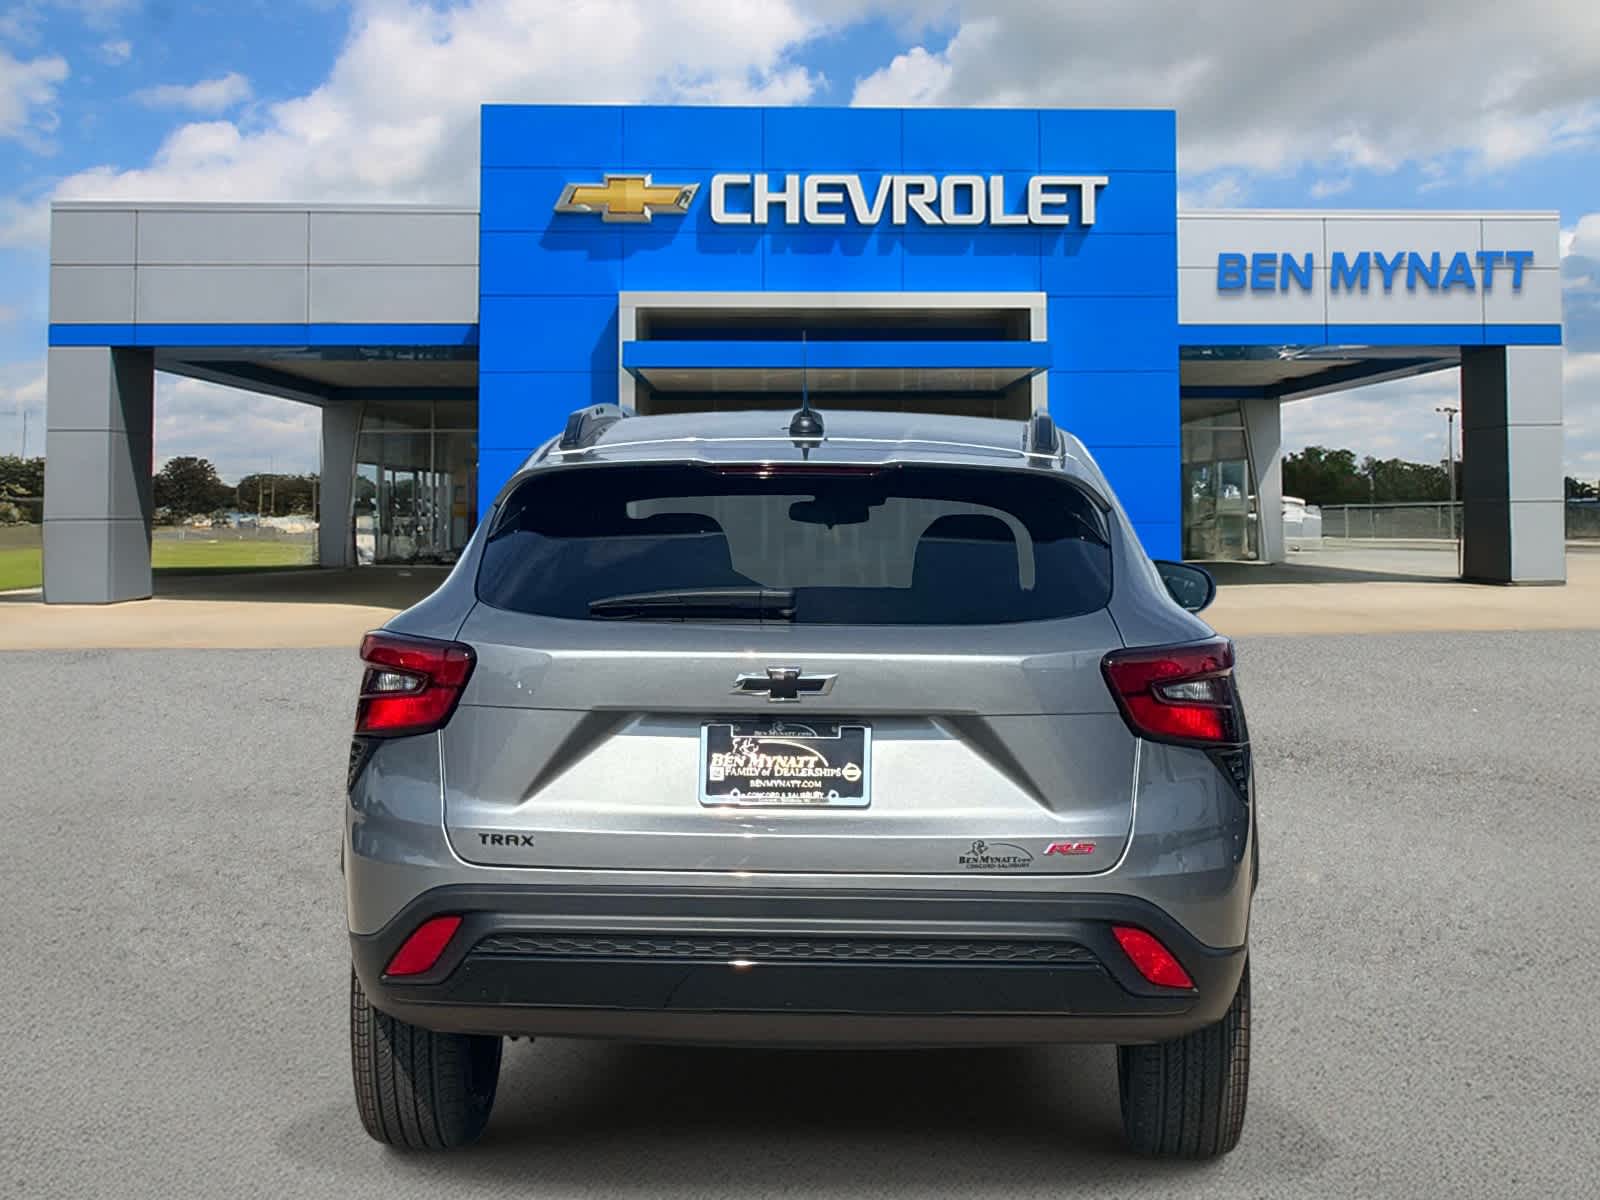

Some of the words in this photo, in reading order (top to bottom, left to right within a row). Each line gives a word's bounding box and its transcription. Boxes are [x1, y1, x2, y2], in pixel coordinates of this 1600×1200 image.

[710, 174, 1109, 226] CHEVROLET
[1217, 252, 1314, 291] BEN
[1330, 250, 1534, 291] MYNATT
[711, 753, 746, 767] BEN
[746, 753, 819, 768] MYNATT
[724, 767, 760, 776] FAMILY
[774, 767, 841, 777] DEALERSHIPS
[749, 779, 822, 788] BENMYNATT.COM
[478, 832, 534, 847] TRAX
[1043, 842, 1097, 856] RS
[958, 855, 978, 865] BEN
